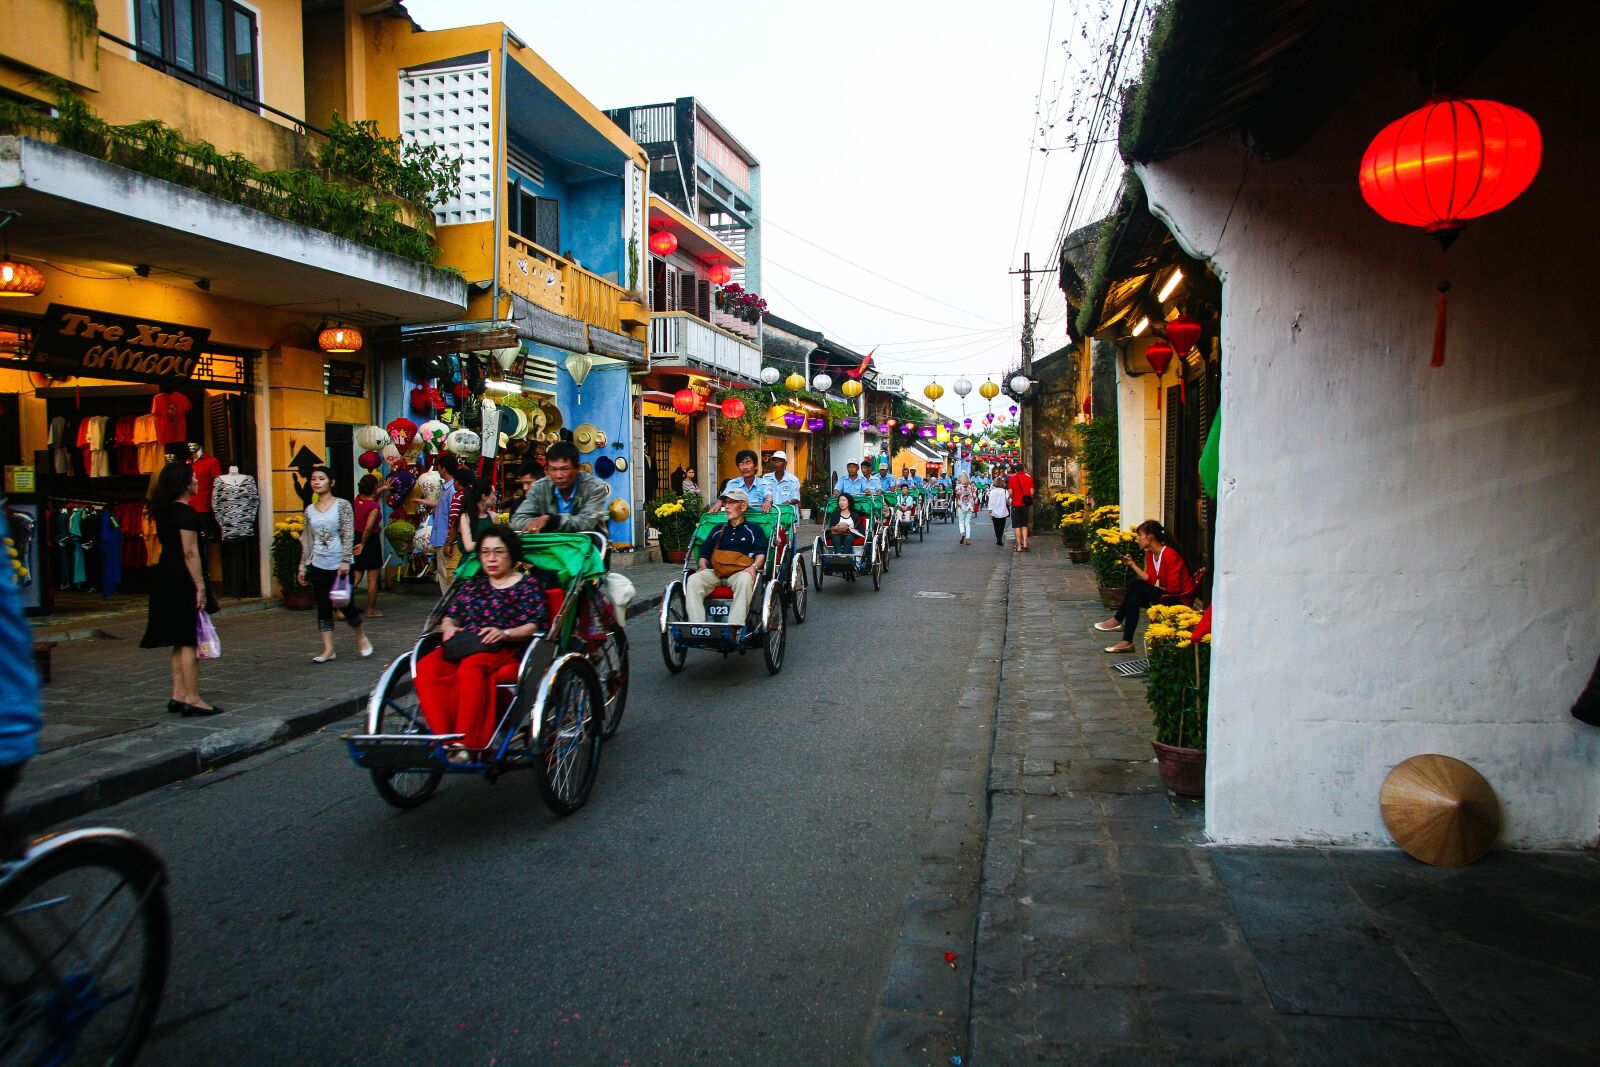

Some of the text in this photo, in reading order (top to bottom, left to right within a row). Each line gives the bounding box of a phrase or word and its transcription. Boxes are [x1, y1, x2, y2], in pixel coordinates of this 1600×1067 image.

[58, 312, 124, 341] Tre
[709, 606, 729, 615] 023
[691, 627, 711, 636] 023
